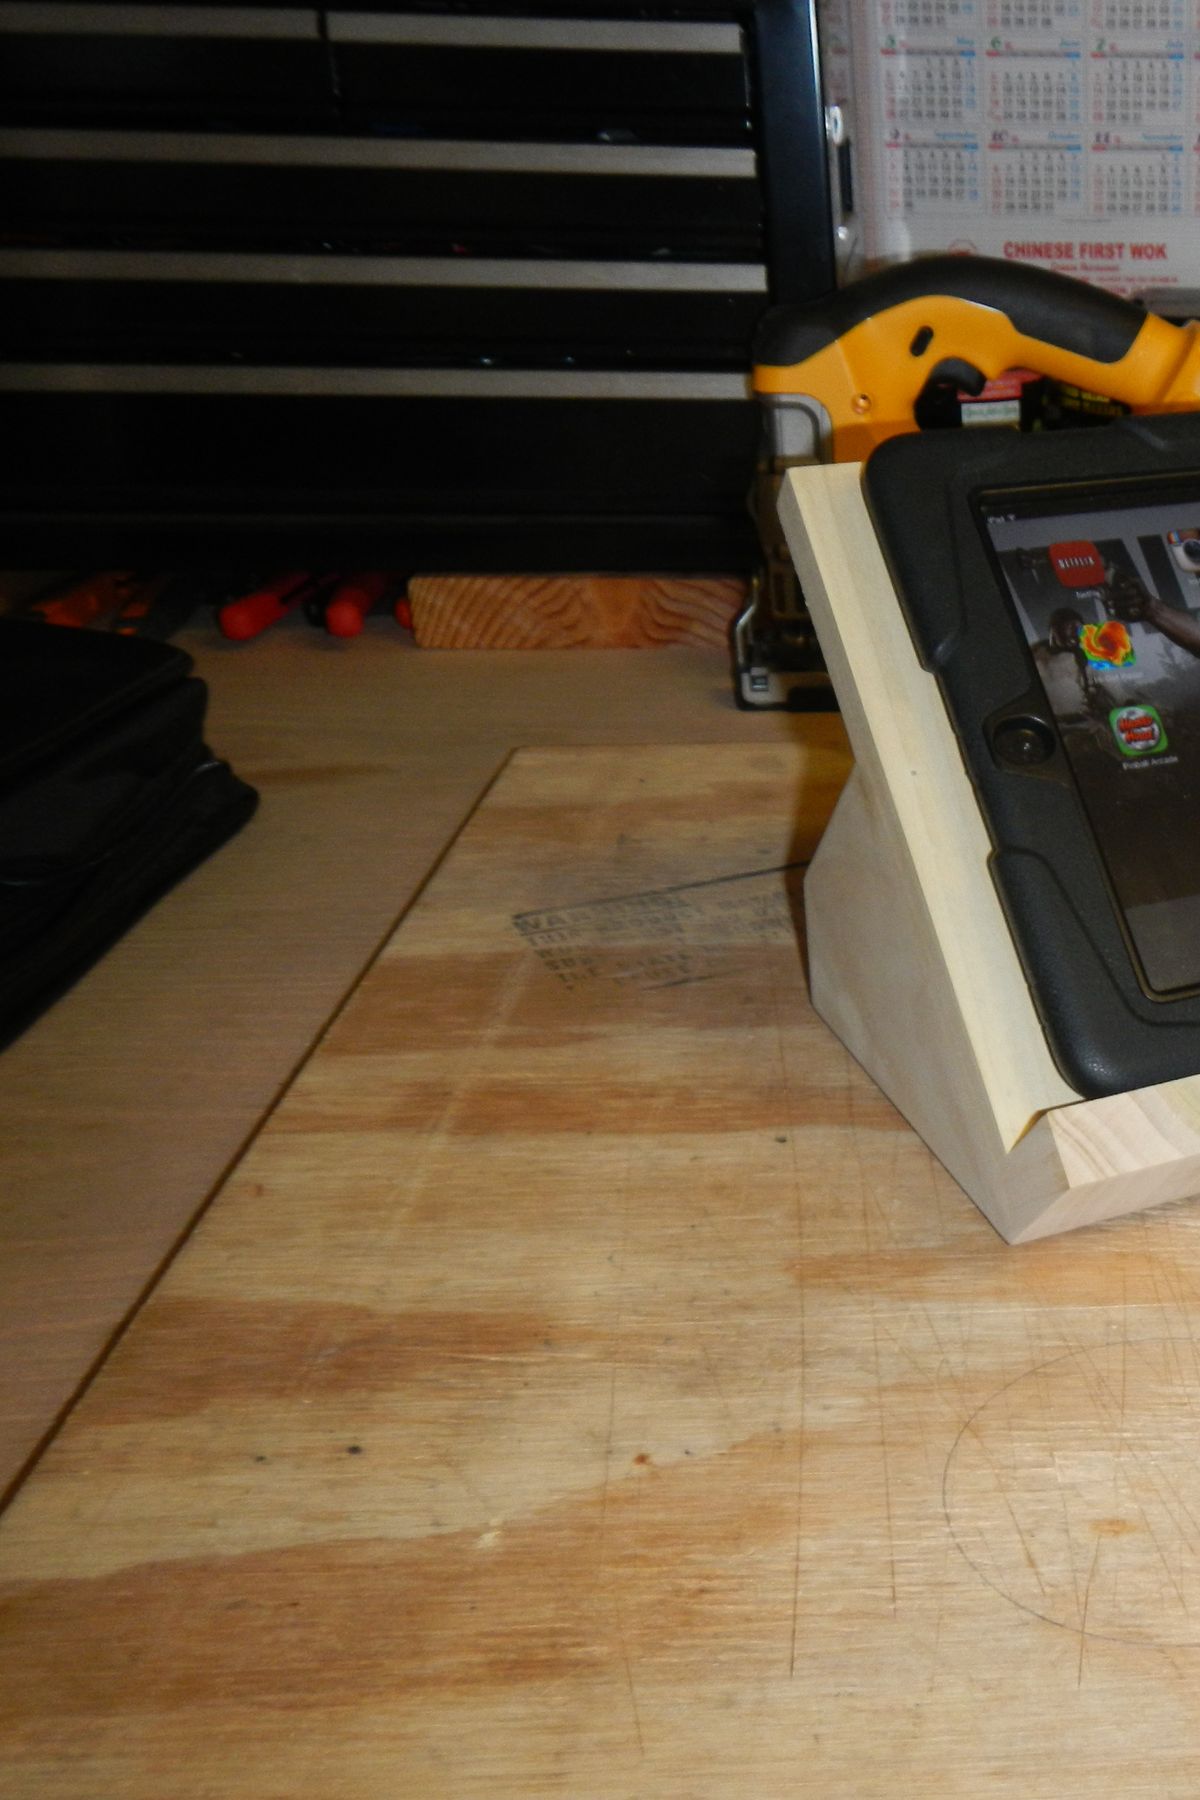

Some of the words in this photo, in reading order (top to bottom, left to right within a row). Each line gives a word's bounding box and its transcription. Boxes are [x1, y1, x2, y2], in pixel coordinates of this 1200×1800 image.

[1003, 242, 1074, 260] CHINESE
[1078, 242, 1125, 260] FIRST
[1129, 243, 1168, 261] WOK
[1058, 556, 1096, 568] NETFLIX
